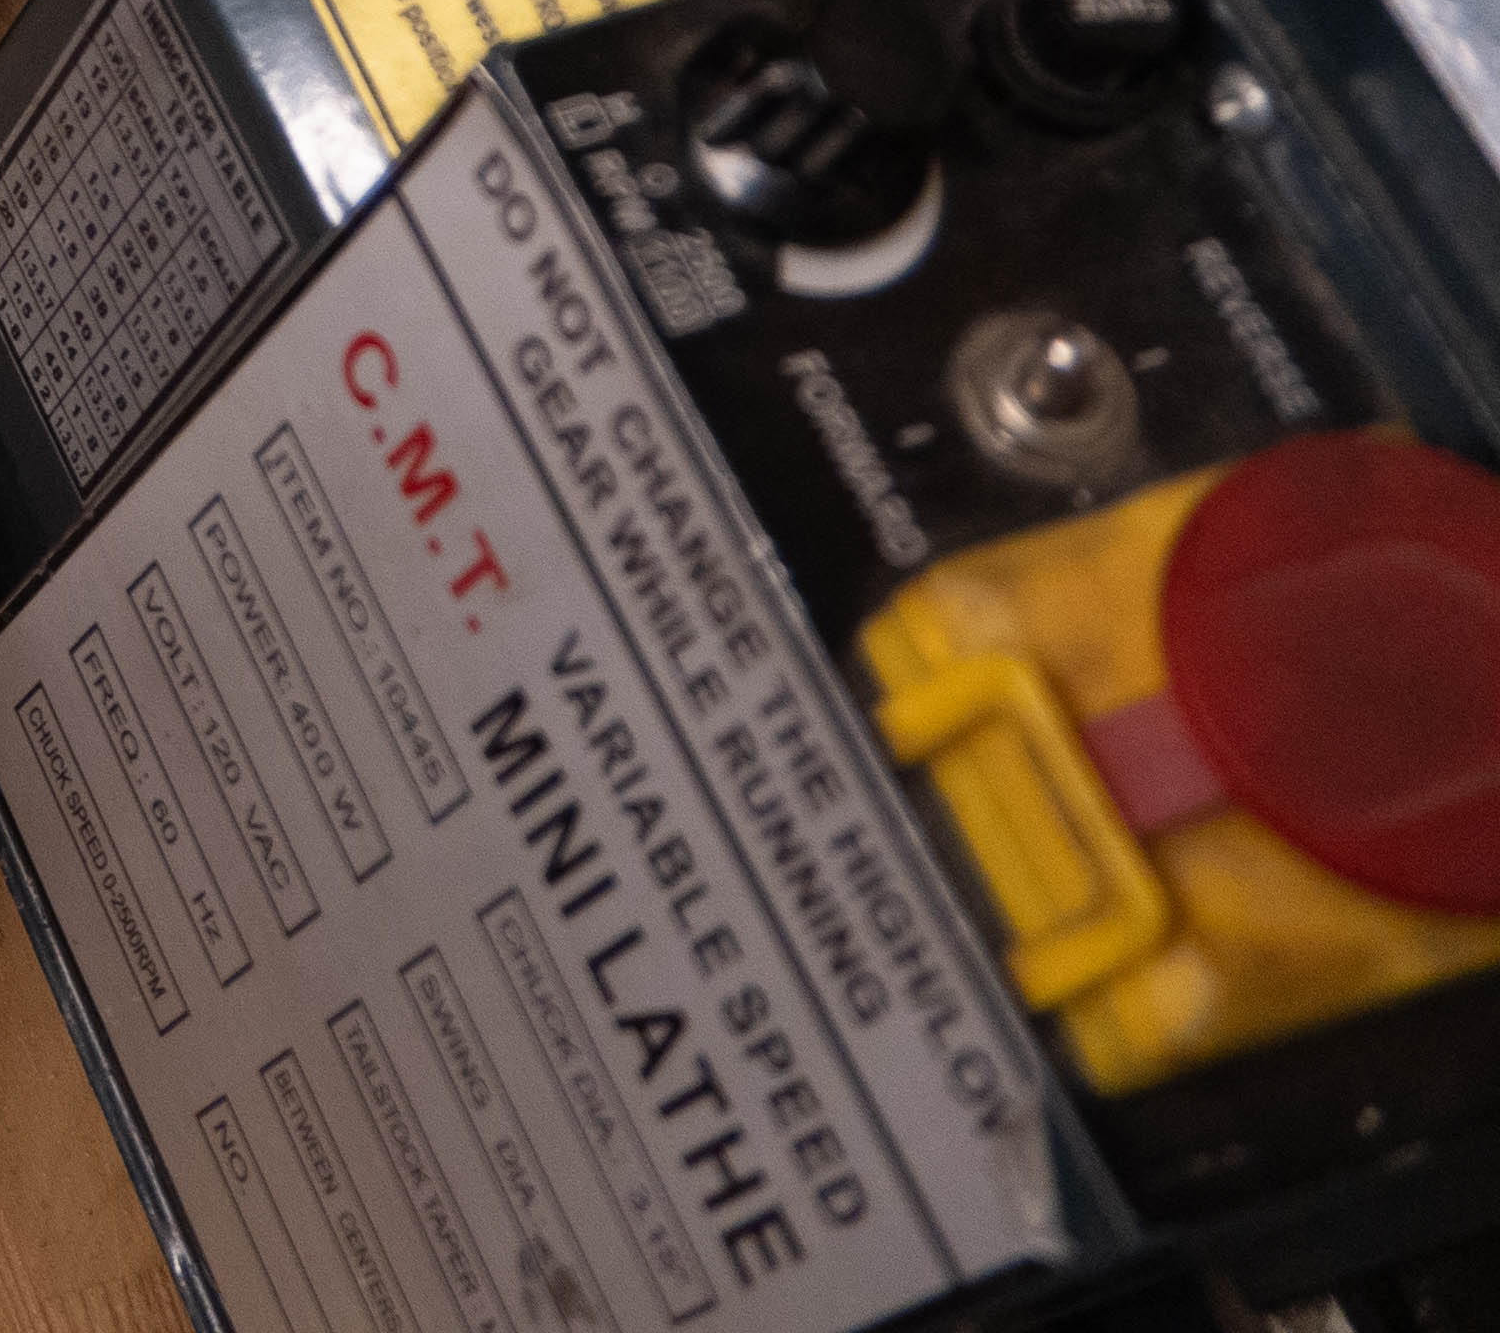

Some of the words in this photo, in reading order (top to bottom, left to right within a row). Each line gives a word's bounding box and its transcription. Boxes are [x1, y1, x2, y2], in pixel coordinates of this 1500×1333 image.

[212, 140, 268, 238] TABLE
[326, 321, 526, 637] C.M.T.
[467, 147, 547, 249] DO
[524, 248, 618, 381] NOT
[603, 399, 774, 672] CHANGE
[750, 675, 850, 815] THE
[769, 337, 939, 578] FORWARD
[265, 448, 337, 560] ITEM
[372, 662, 451, 790] 10445
[507, 331, 626, 511] GEAR
[603, 513, 736, 719] WHILE
[709, 720, 897, 1028] RUNNING
[23, 703, 74, 789] CHUCK
[62, 789, 113, 874] SPEED
[99, 871, 170, 1002] 0-2500RPM
[146, 796, 183, 848] 60
[189, 888, 229, 947] Hz
[198, 715, 245, 788] 120
[238, 801, 297, 894] VAC
[285, 697, 339, 780] 400
[325, 785, 367, 838] W
[413, 970, 497, 1113] SWING
[463, 686, 624, 921] MINI
[579, 925, 810, 1294] LATHE
[493, 912, 584, 1063] CHUCK
[540, 628, 748, 979] VARIABLE
[715, 978, 876, 1236] SPEED
[271, 1068, 342, 1198] BETWEEN
[340, 1021, 435, 1192] TAILSTOCK
[419, 1190, 484, 1300] TAPER
